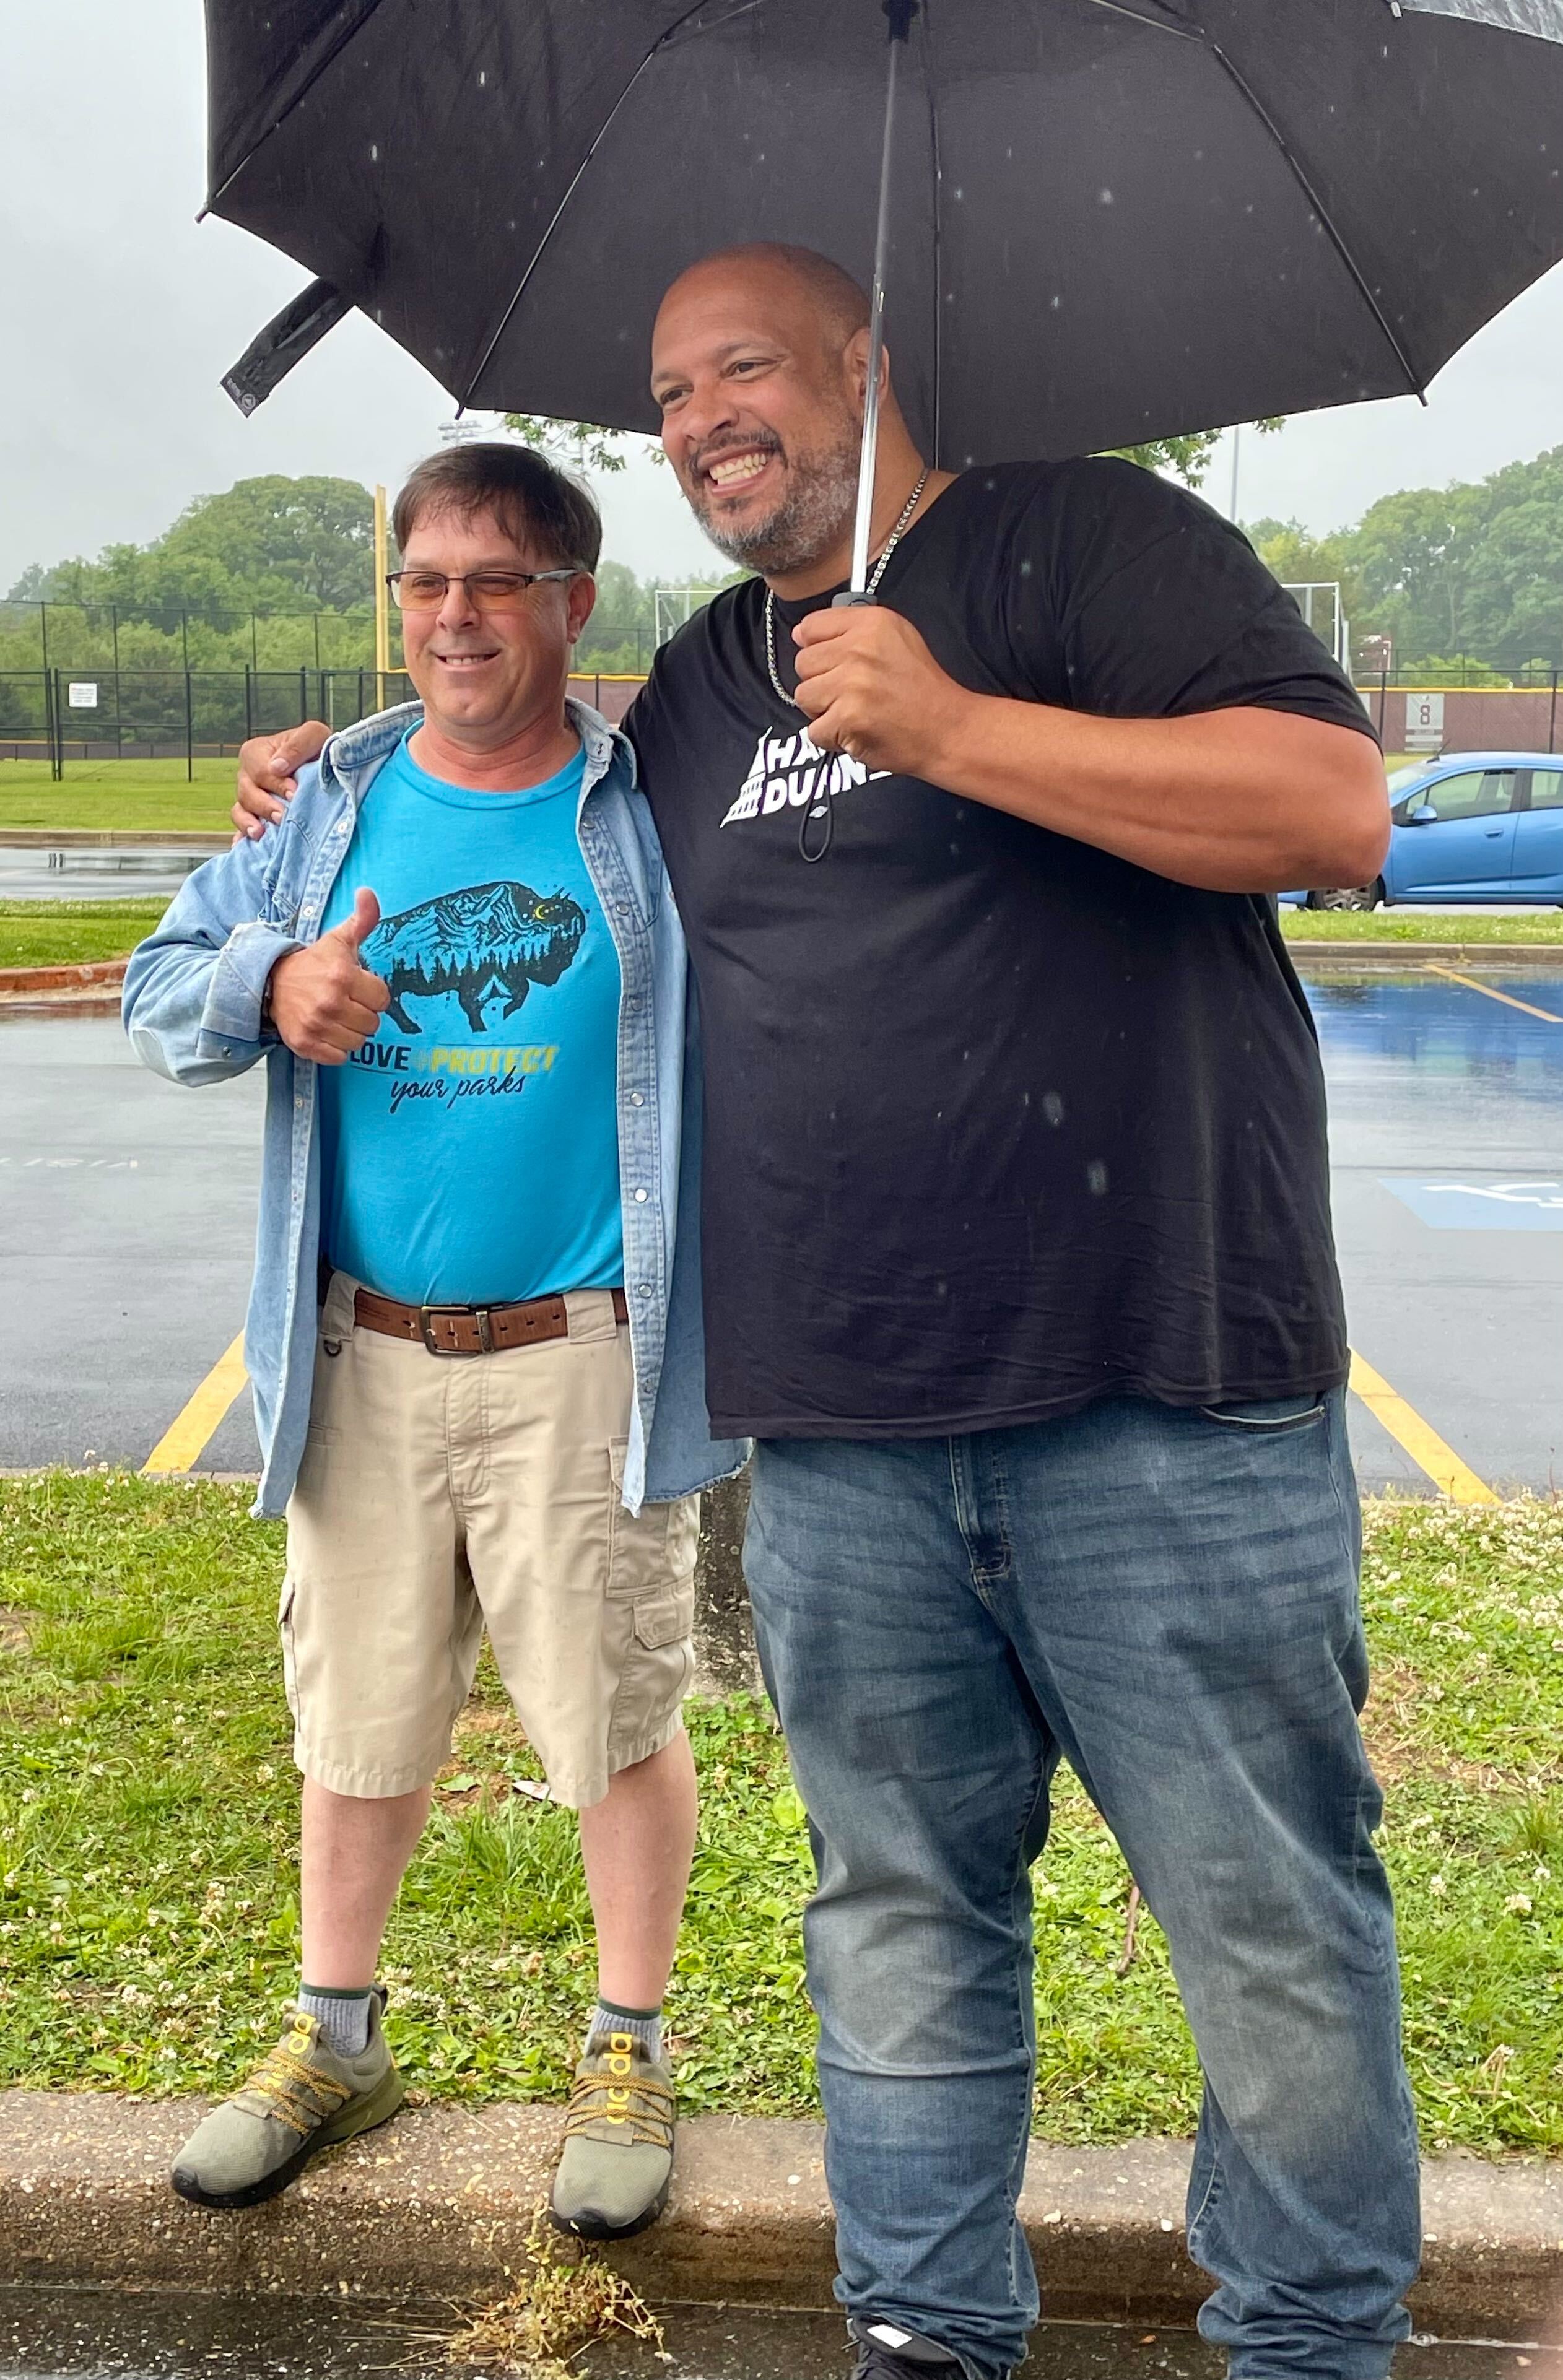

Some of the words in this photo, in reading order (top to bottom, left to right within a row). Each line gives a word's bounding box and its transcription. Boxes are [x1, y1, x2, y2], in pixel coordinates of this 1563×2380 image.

[1419, 704, 1431, 725] 8
[350, 1041, 412, 1071] LOVE
[430, 1045, 559, 1074] PROTECT
[390, 1079, 450, 1114] your
[446, 1065, 526, 1110] parks
